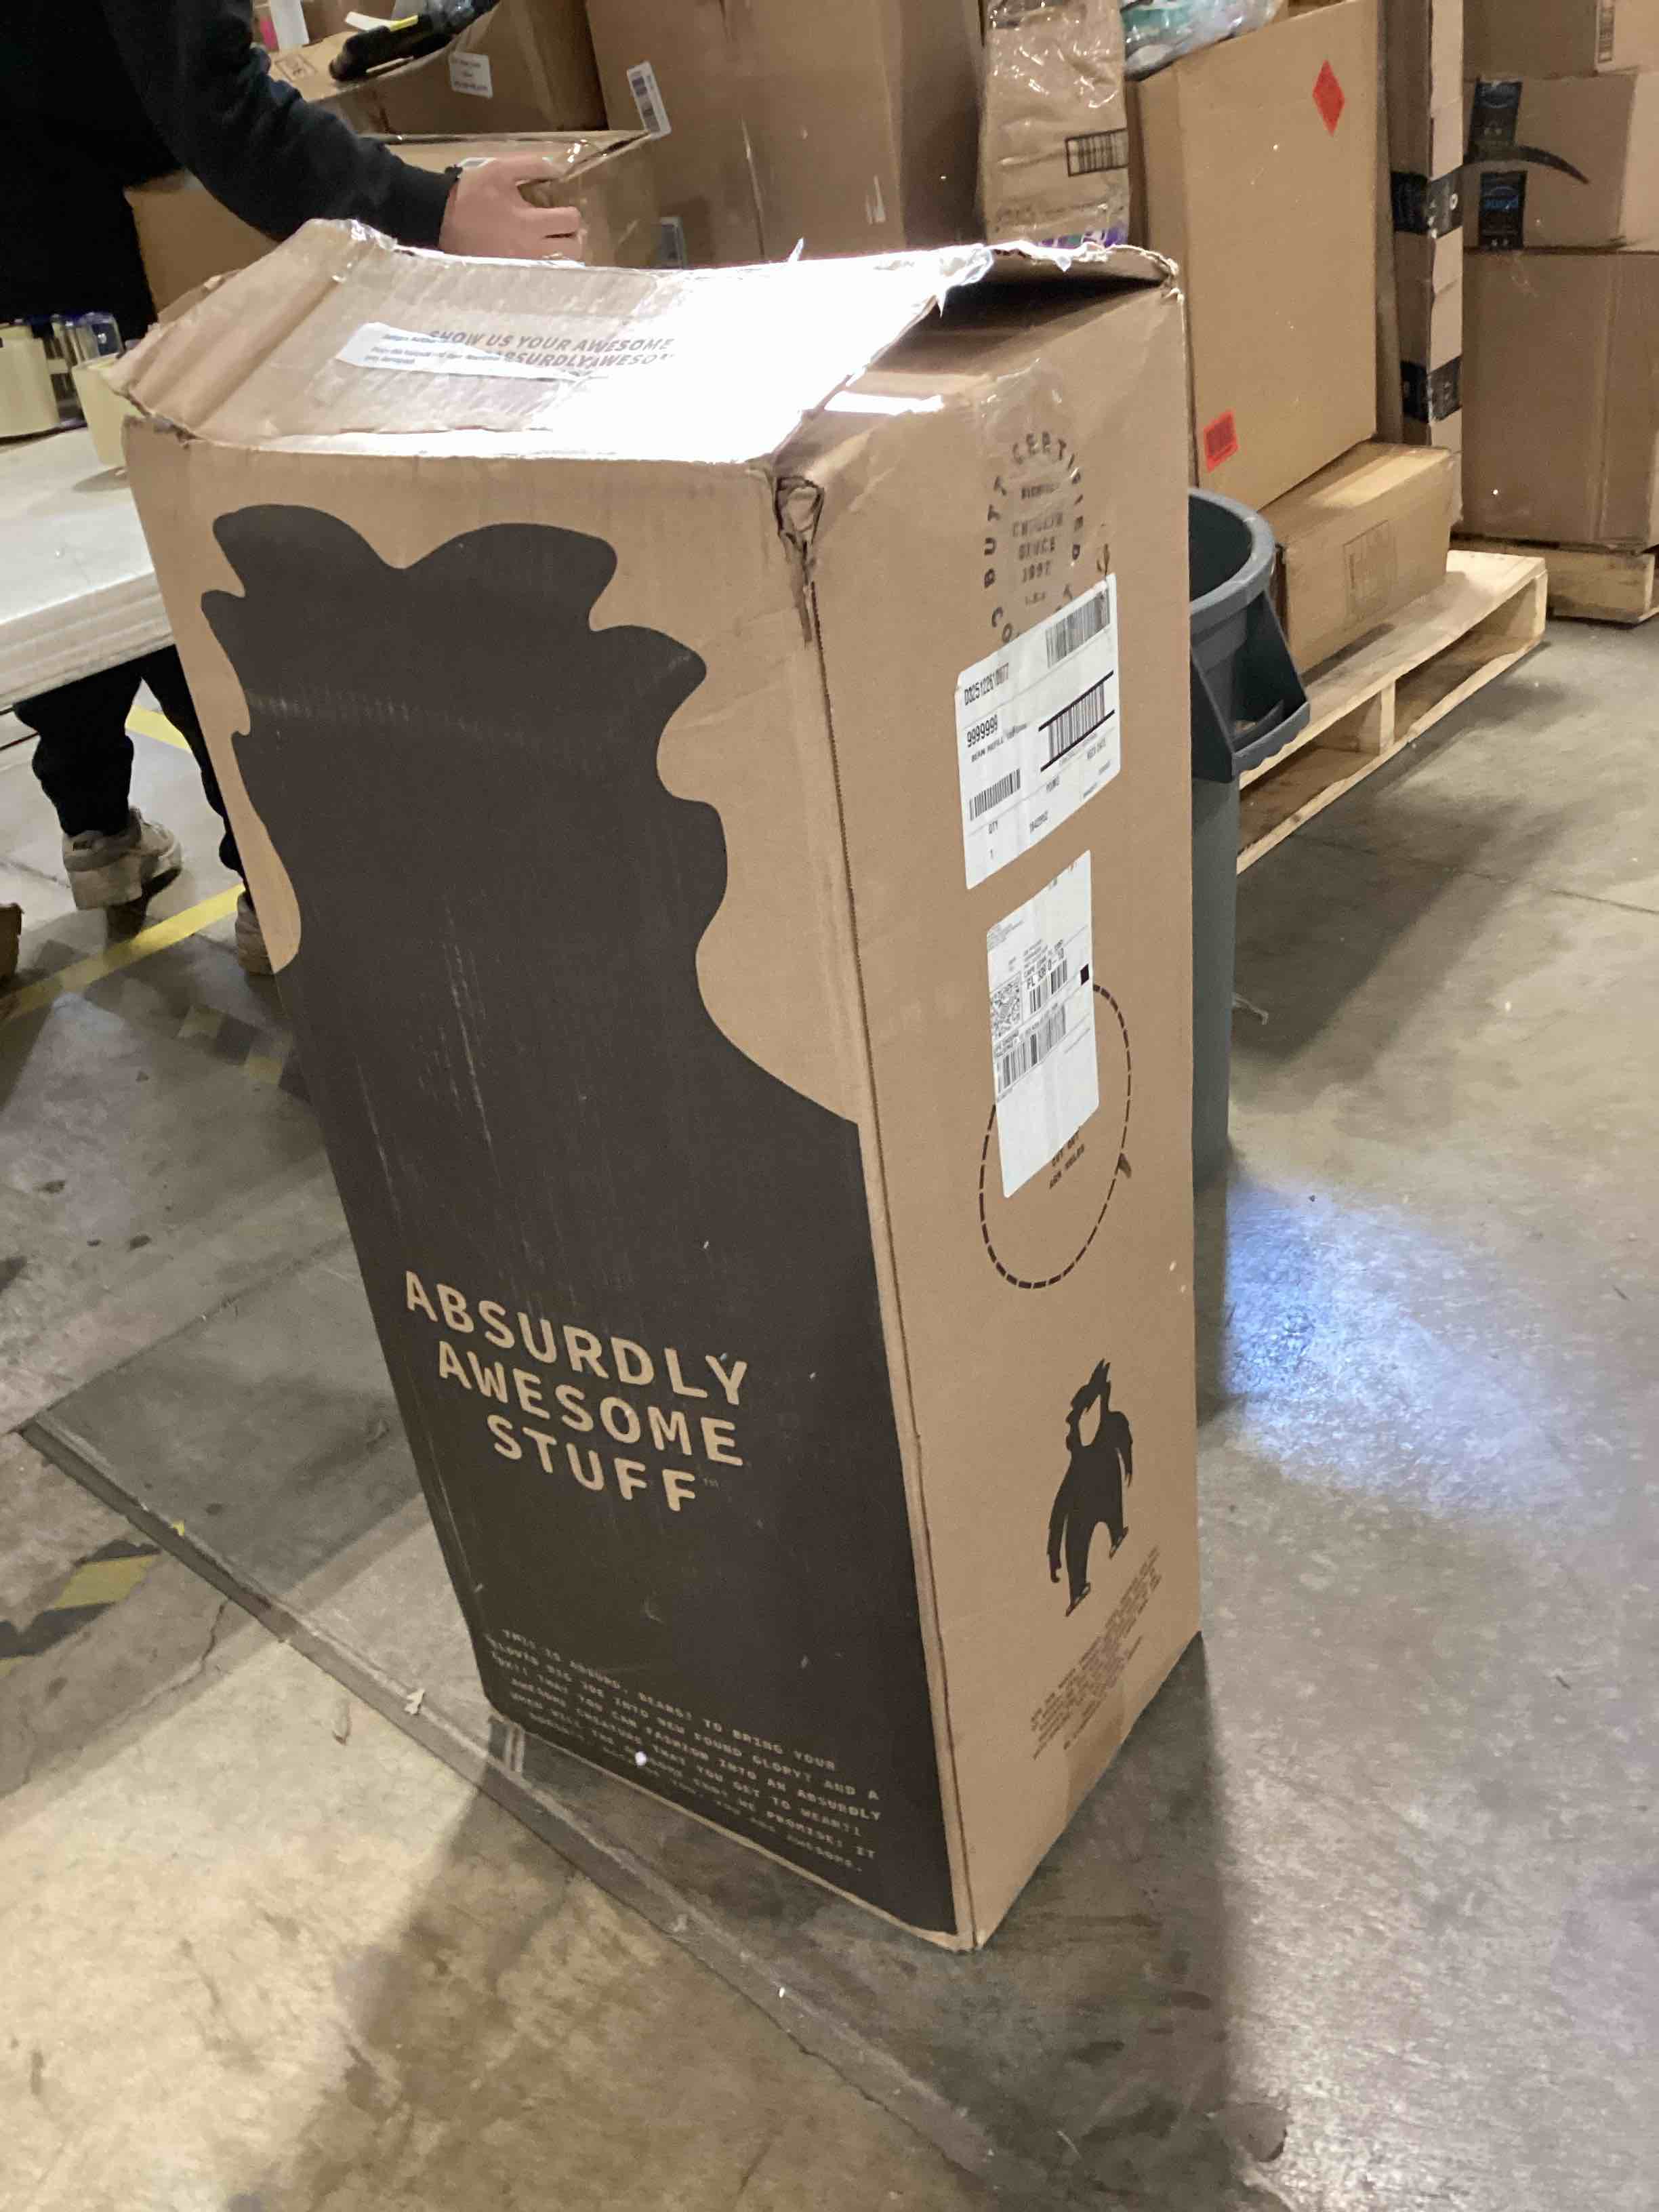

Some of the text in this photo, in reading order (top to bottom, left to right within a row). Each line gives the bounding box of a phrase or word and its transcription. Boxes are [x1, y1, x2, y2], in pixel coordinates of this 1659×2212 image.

[486, 334, 513, 348] US
[516, 335, 572, 351] YOUR
[573, 338, 674, 353] AWESOME
[406, 1270, 747, 1406] ABSURDLY
[439, 1340, 743, 1467] AWESOME
[487, 1414, 696, 1512] STUFF
[798, 1788, 881, 1822] ABSURDLY
